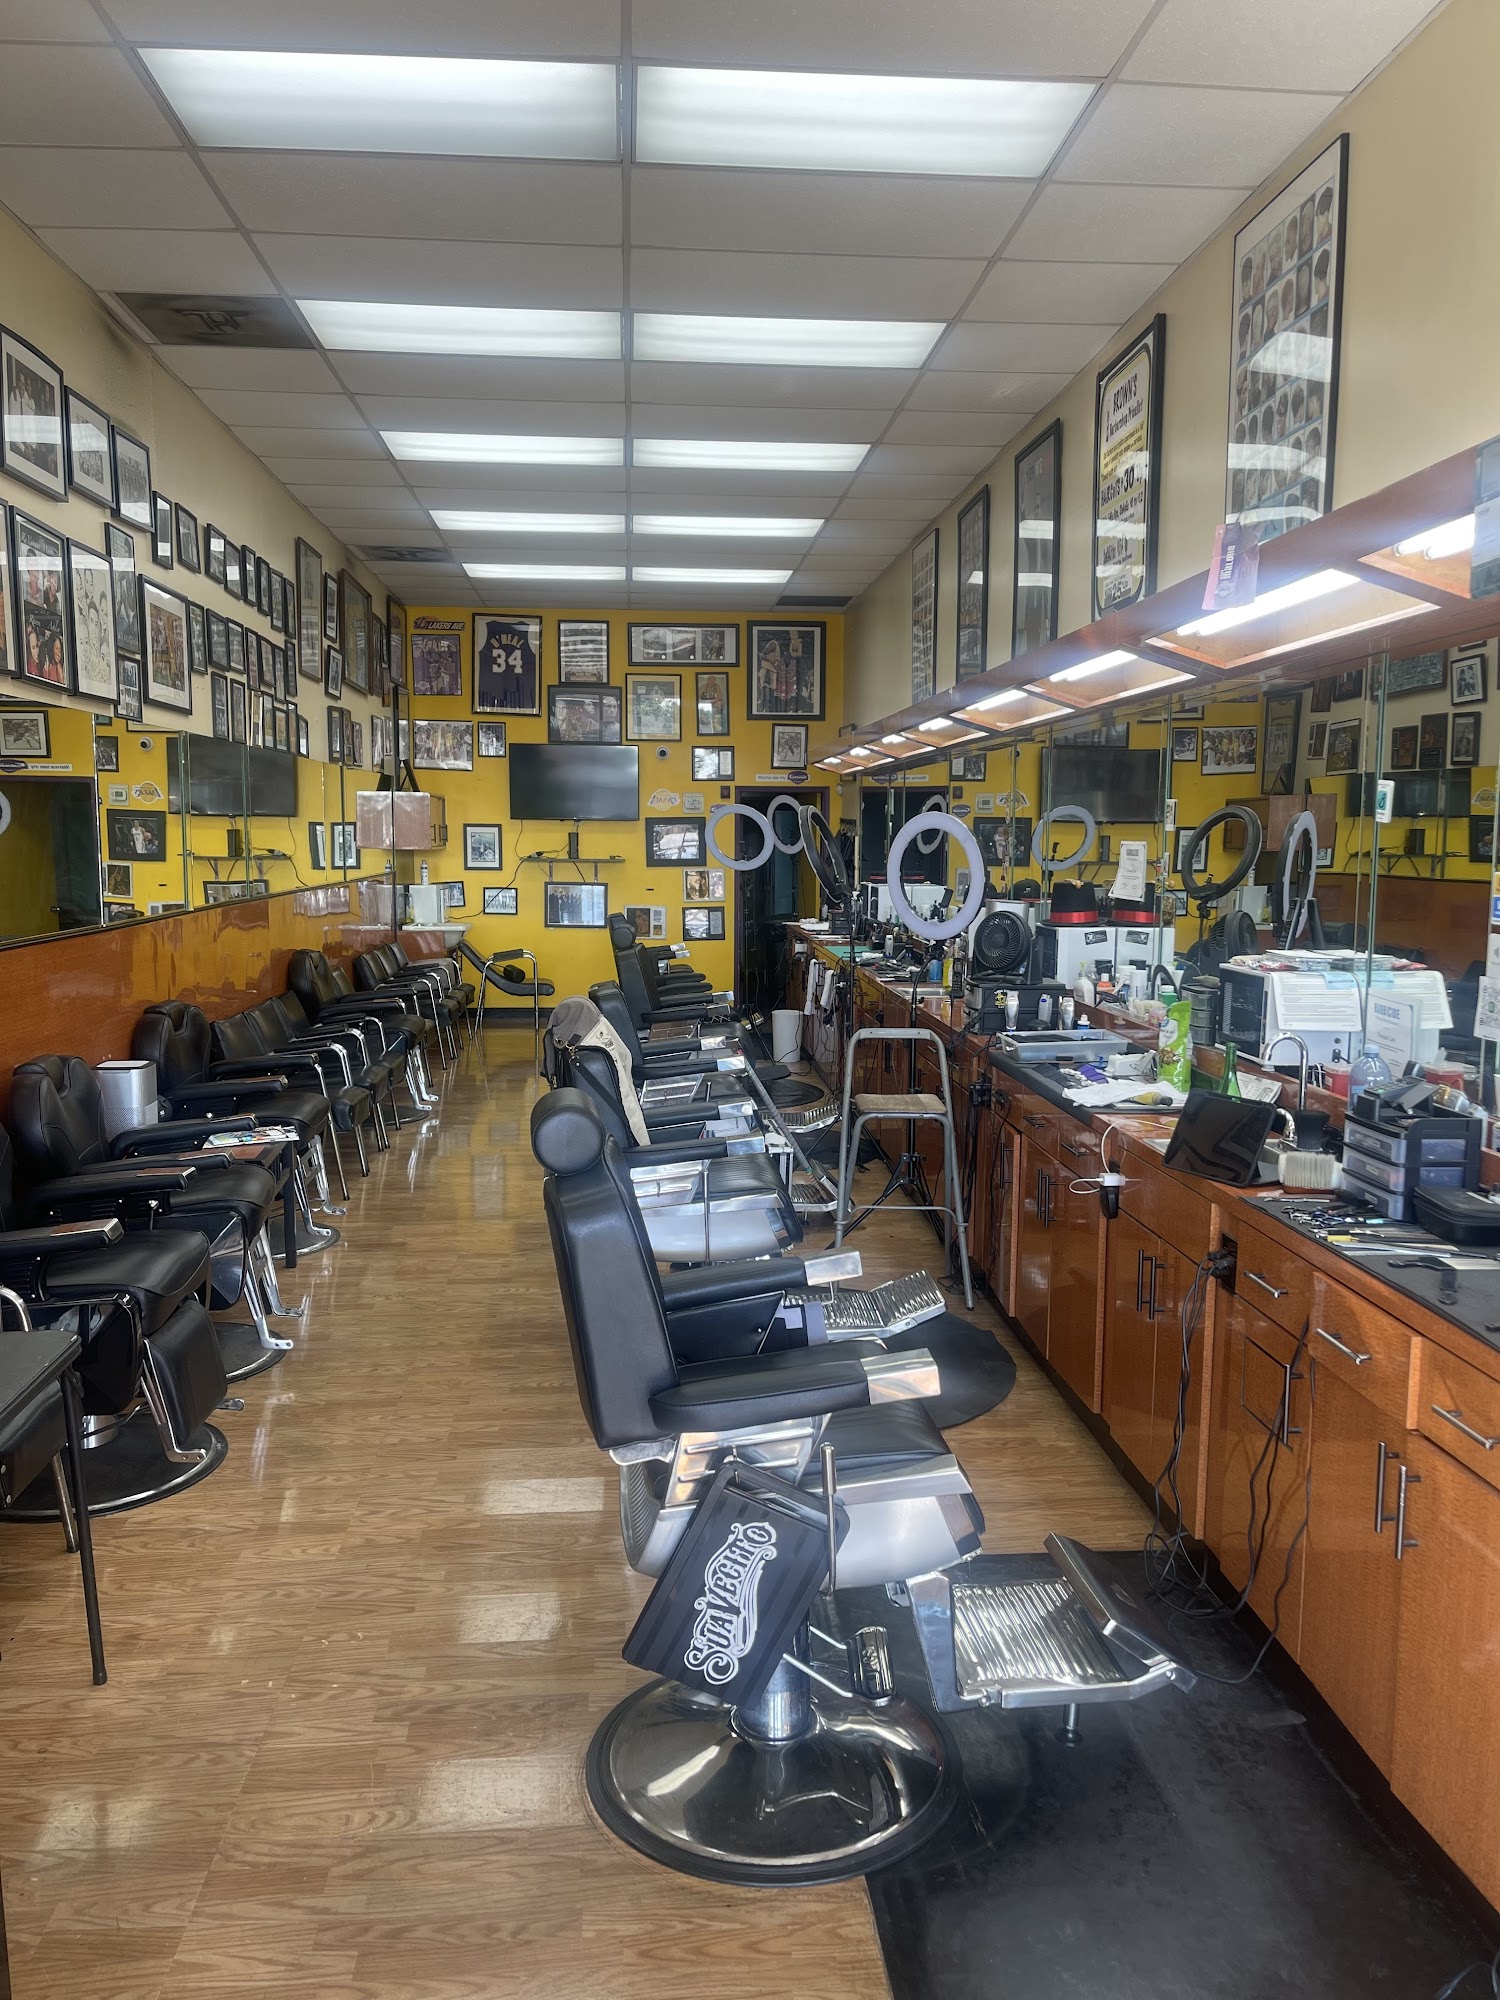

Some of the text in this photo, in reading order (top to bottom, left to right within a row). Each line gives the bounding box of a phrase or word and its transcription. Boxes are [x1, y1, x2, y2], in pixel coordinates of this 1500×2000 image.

[428, 621, 452, 630] LAKERS
[492, 649, 523, 674] 34
[683, 1521, 777, 1686] SUAVECITO
